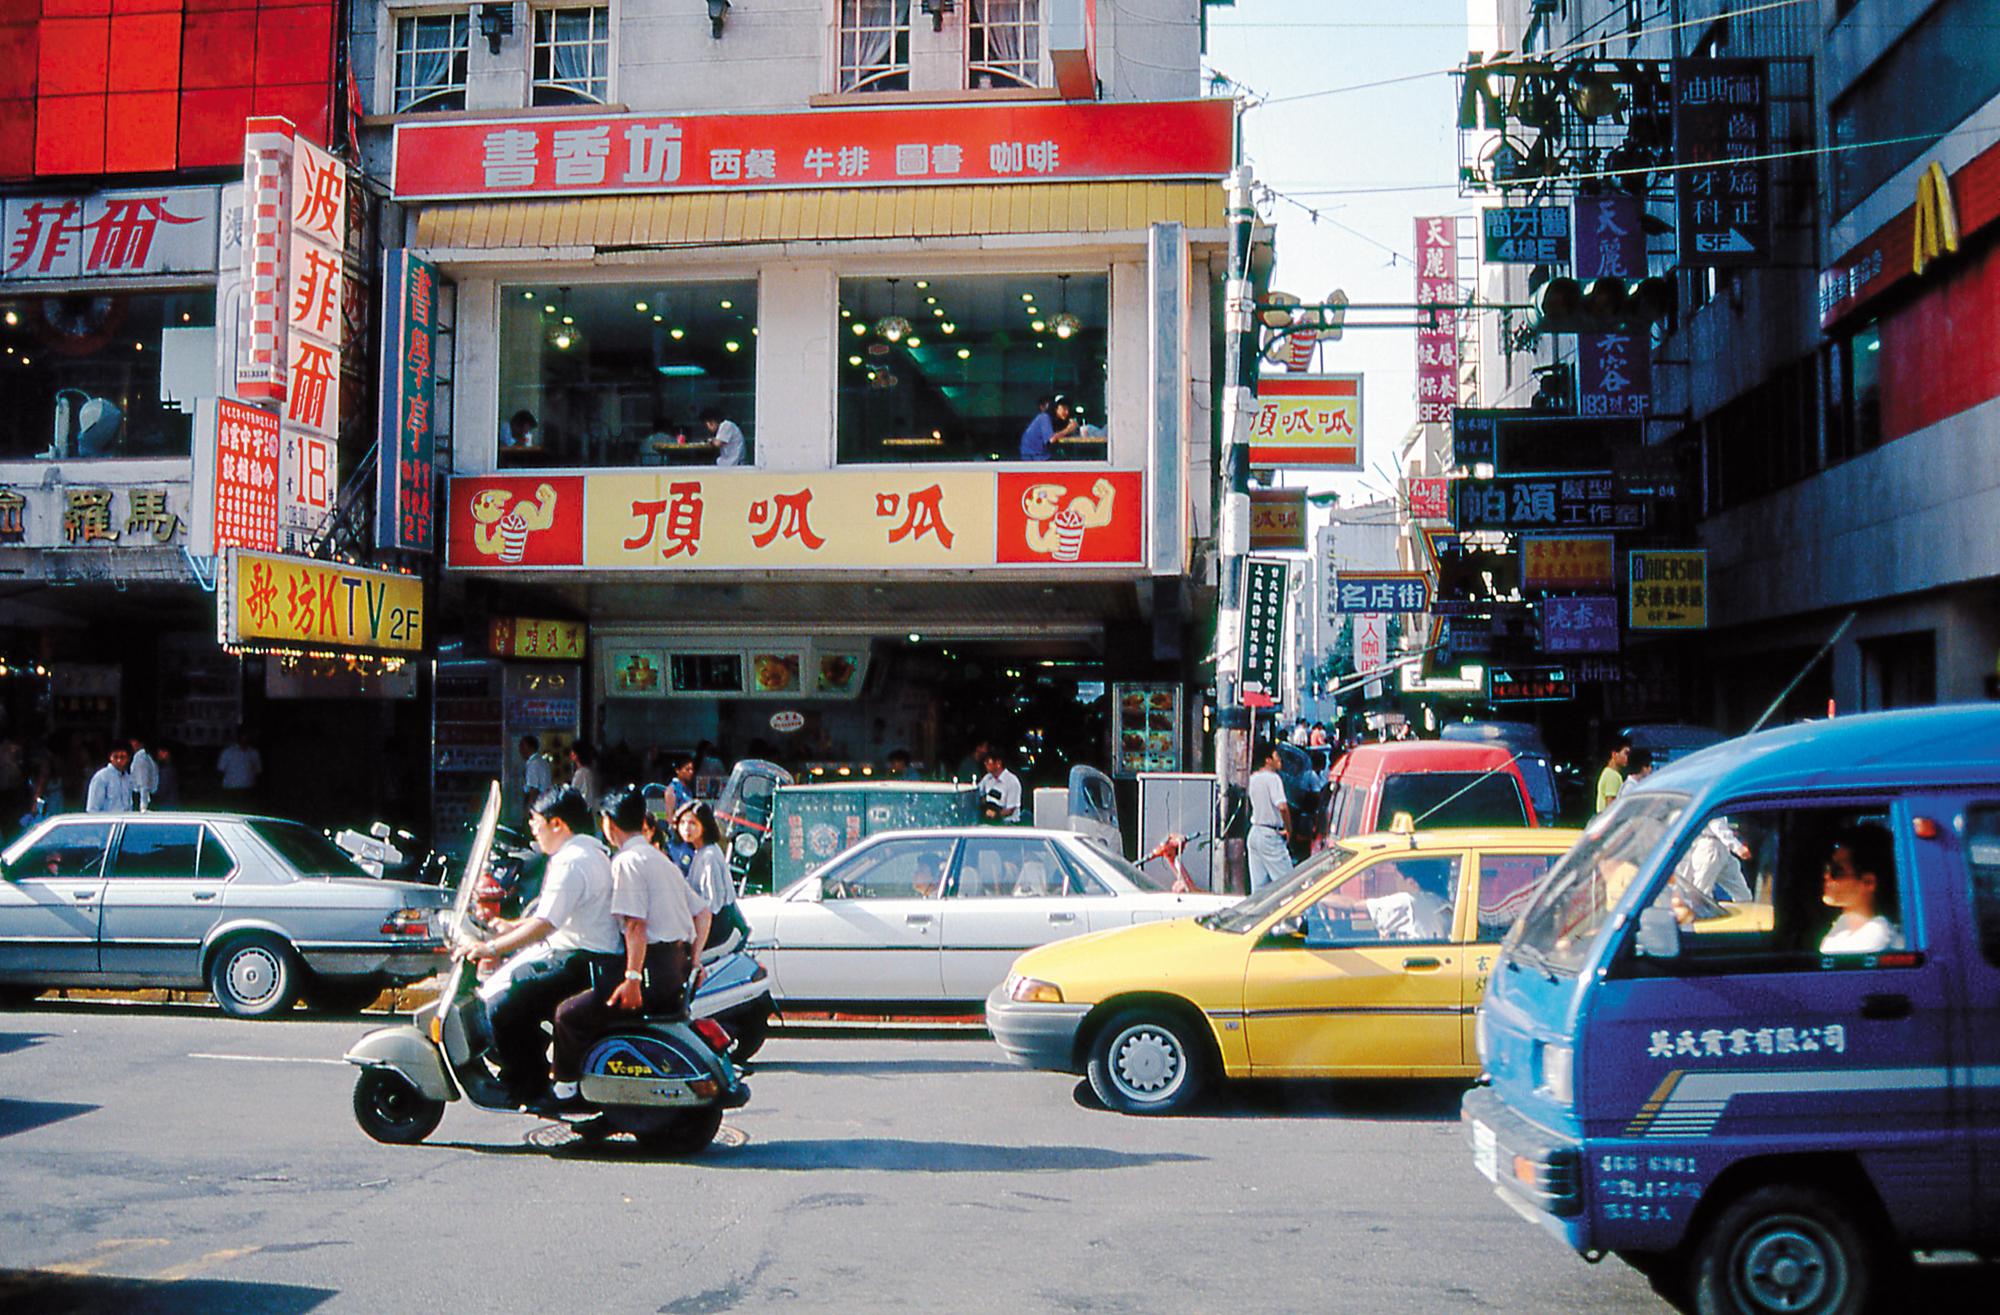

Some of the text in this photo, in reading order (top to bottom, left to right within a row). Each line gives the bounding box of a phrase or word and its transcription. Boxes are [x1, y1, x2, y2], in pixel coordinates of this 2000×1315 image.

[482, 124, 1060, 187] 書香坊 西餐 牛排 圖書 咖啡
[1423, 217, 1451, 279] 天麗
[1701, 236, 1731, 250] 3F
[287, 144, 341, 429] 波菲爾
[297, 436, 326, 508] 18
[64, 488, 188, 544] 羅馬
[623, 480, 955, 559] 頂呱呱
[390, 608, 420, 641] 2F
[1341, 582, 1424, 609] 名店街
[607, 1061, 653, 1077] Vespa
